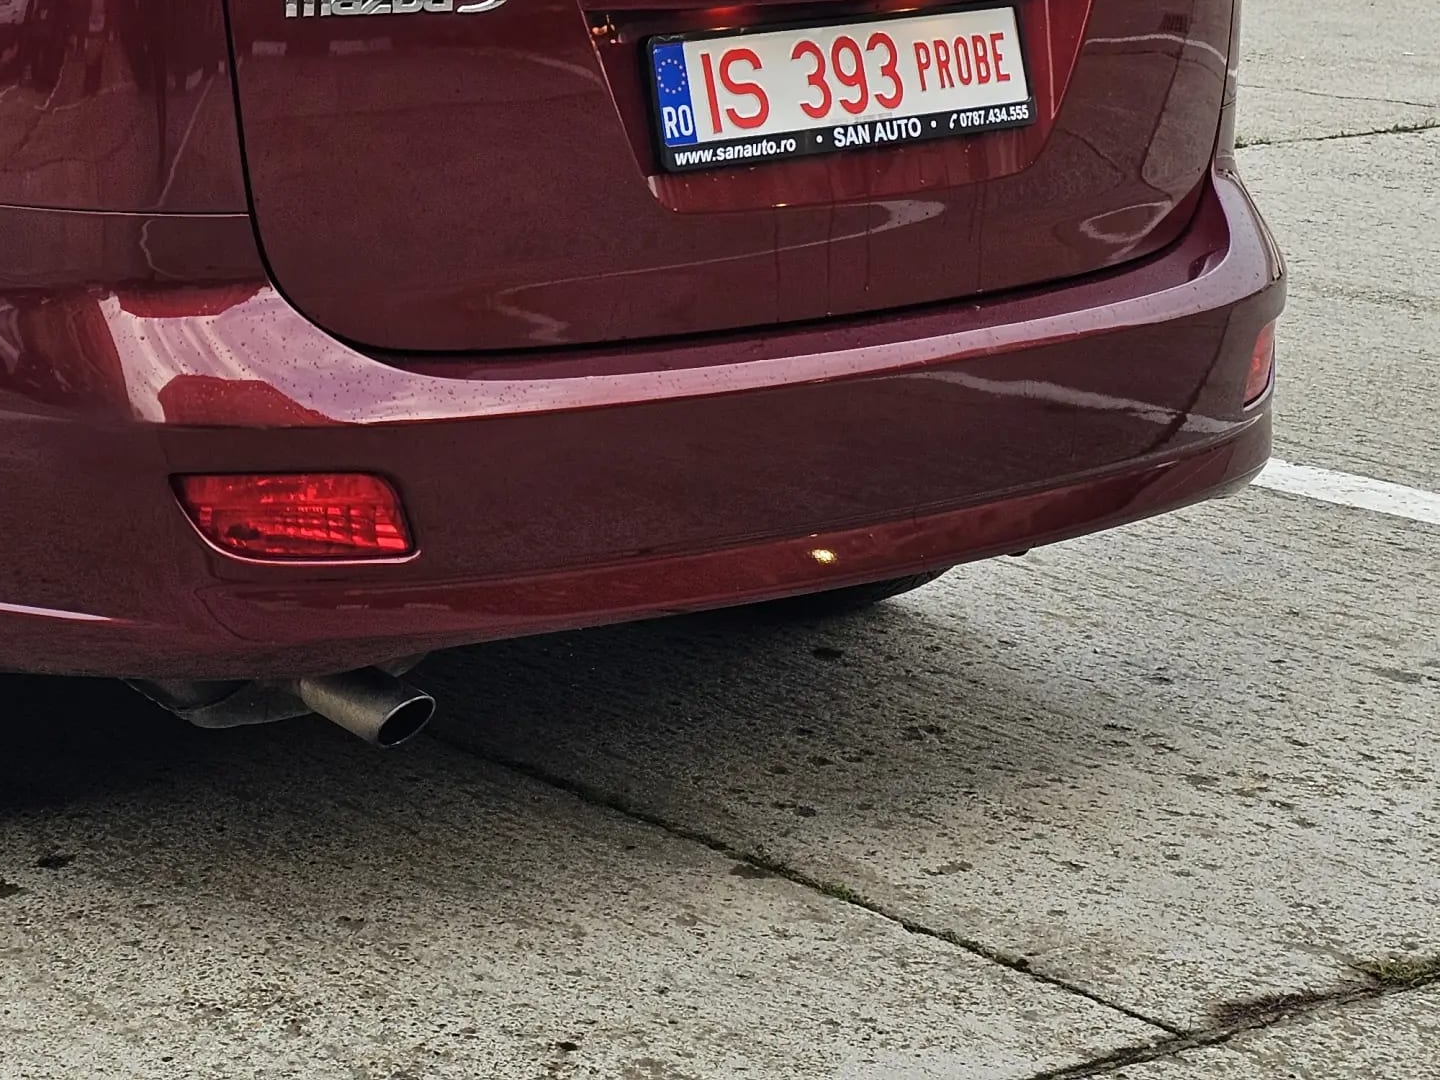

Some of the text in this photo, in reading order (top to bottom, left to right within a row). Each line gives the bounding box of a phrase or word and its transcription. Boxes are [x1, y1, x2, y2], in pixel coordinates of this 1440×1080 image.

[662, 32, 1010, 139] RO IS 393 PROBE
[674, 105, 1029, 166] www.sanauto.ro SAN AUTO 0787.434.555
